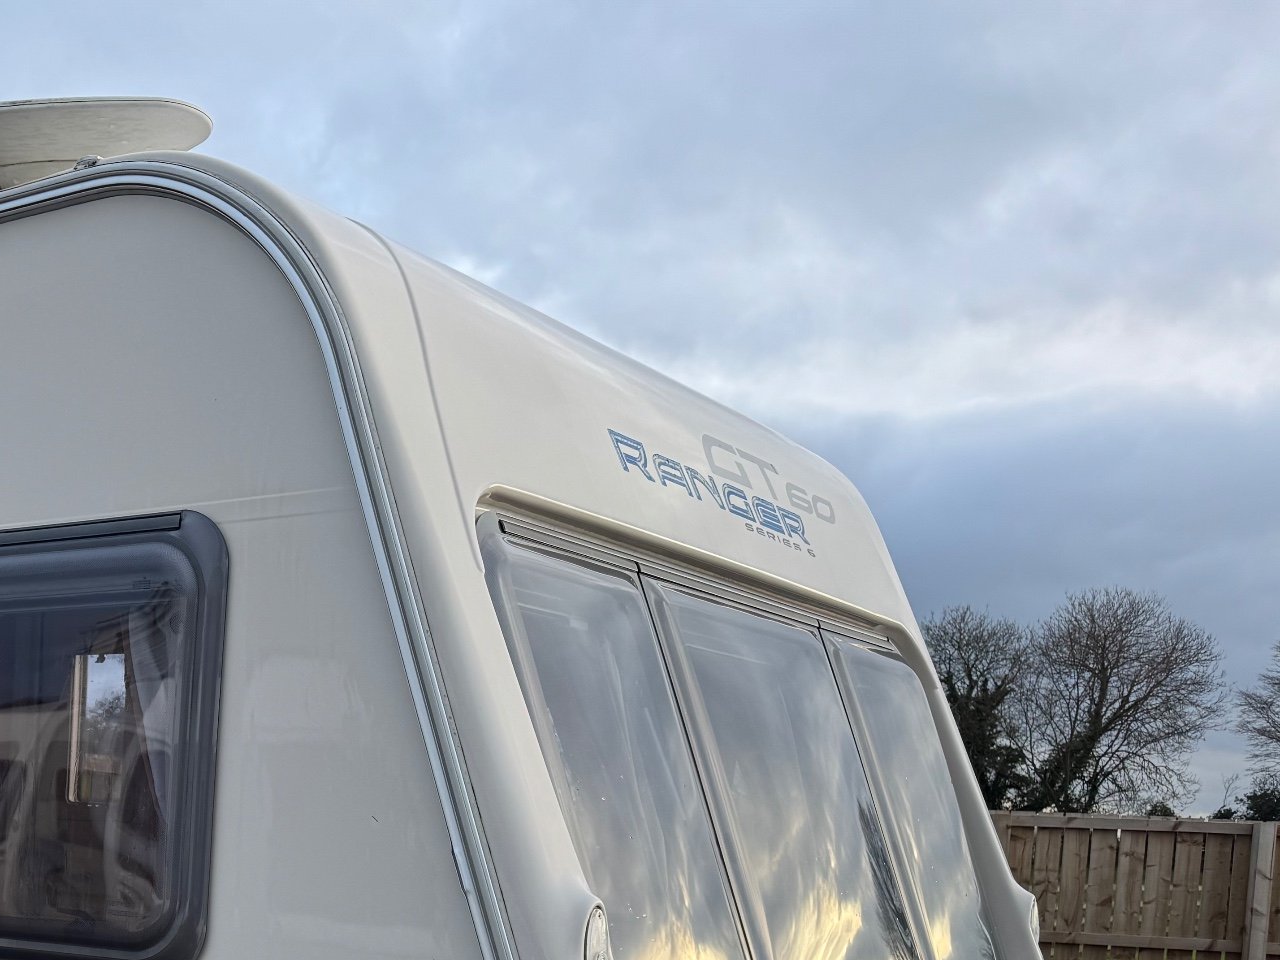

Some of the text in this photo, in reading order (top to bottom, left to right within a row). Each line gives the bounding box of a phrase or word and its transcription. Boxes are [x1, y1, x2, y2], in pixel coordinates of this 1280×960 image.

[607, 428, 810, 545] RANGER
[745, 522, 816, 558] SERIES 6
